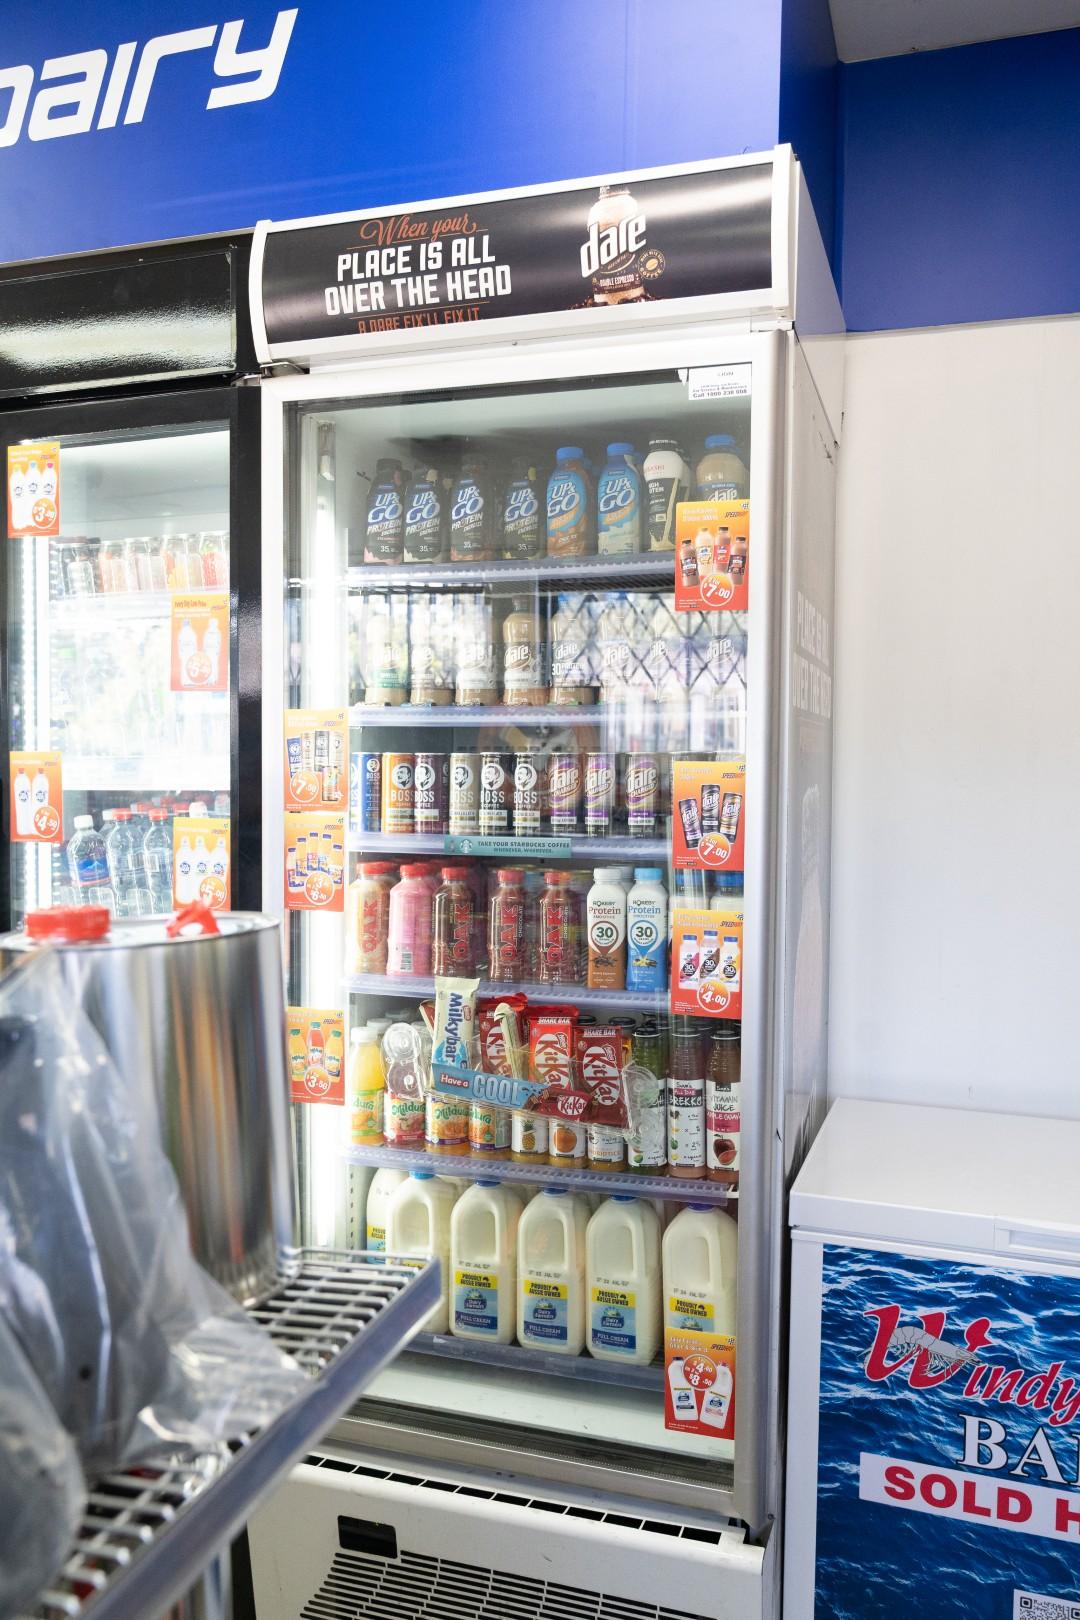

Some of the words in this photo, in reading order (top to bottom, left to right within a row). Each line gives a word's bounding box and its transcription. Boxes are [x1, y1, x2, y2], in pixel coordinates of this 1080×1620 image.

[359, 214, 429, 247] When
[431, 213, 478, 241] your
[337, 245, 412, 282] PLACE
[419, 241, 443, 271] IS
[451, 234, 496, 267] ALL
[580, 214, 647, 278] dare
[324, 281, 386, 316] OVER
[391, 273, 440, 308] THE
[446, 264, 512, 302] HEAD
[451, 496, 484, 520] GO
[504, 500, 539, 521] GO
[547, 492, 580, 517] GO
[600, 488, 636, 512] GO
[367, 503, 403, 523] GO
[406, 502, 441, 523] GO
[505, 644, 529, 668] dare
[550, 768, 579, 793] dare
[585, 768, 611, 792] dare
[627, 768, 657, 793] dare
[453, 791, 474, 803] OSS
[514, 791, 538, 804] BOSS
[588, 906, 621, 915] Protein
[628, 906, 661, 914] Protein
[362, 900, 378, 953] OAK
[453, 903, 473, 961] OAK
[500, 905, 518, 962] OAK
[546, 906, 564, 966] OAK
[596, 926, 614, 938] 30
[635, 926, 653, 938] 30
[445, 992, 463, 1063] Milkybar
[440, 1074, 462, 1085] Have
[462, 1080, 469, 1088] a
[473, 1074, 521, 1106] COOL
[584, 1053, 620, 1104] KitKat
[353, 1096, 375, 1111] dura
[391, 1101, 426, 1116] Mildura
[560, 1096, 587, 1115] KitKat
[713, 1104, 735, 1112] JUICE
[462, 1273, 482, 1282] PROUDLY
[531, 1282, 551, 1291] PROUDLY
[598, 1290, 619, 1299] PROUDLY
[676, 1300, 697, 1309] PROUDLY
[862, 1303, 1080, 1427] Windy
[956, 1411, 1080, 1487] BA
[883, 1465, 1033, 1524] SOLD
